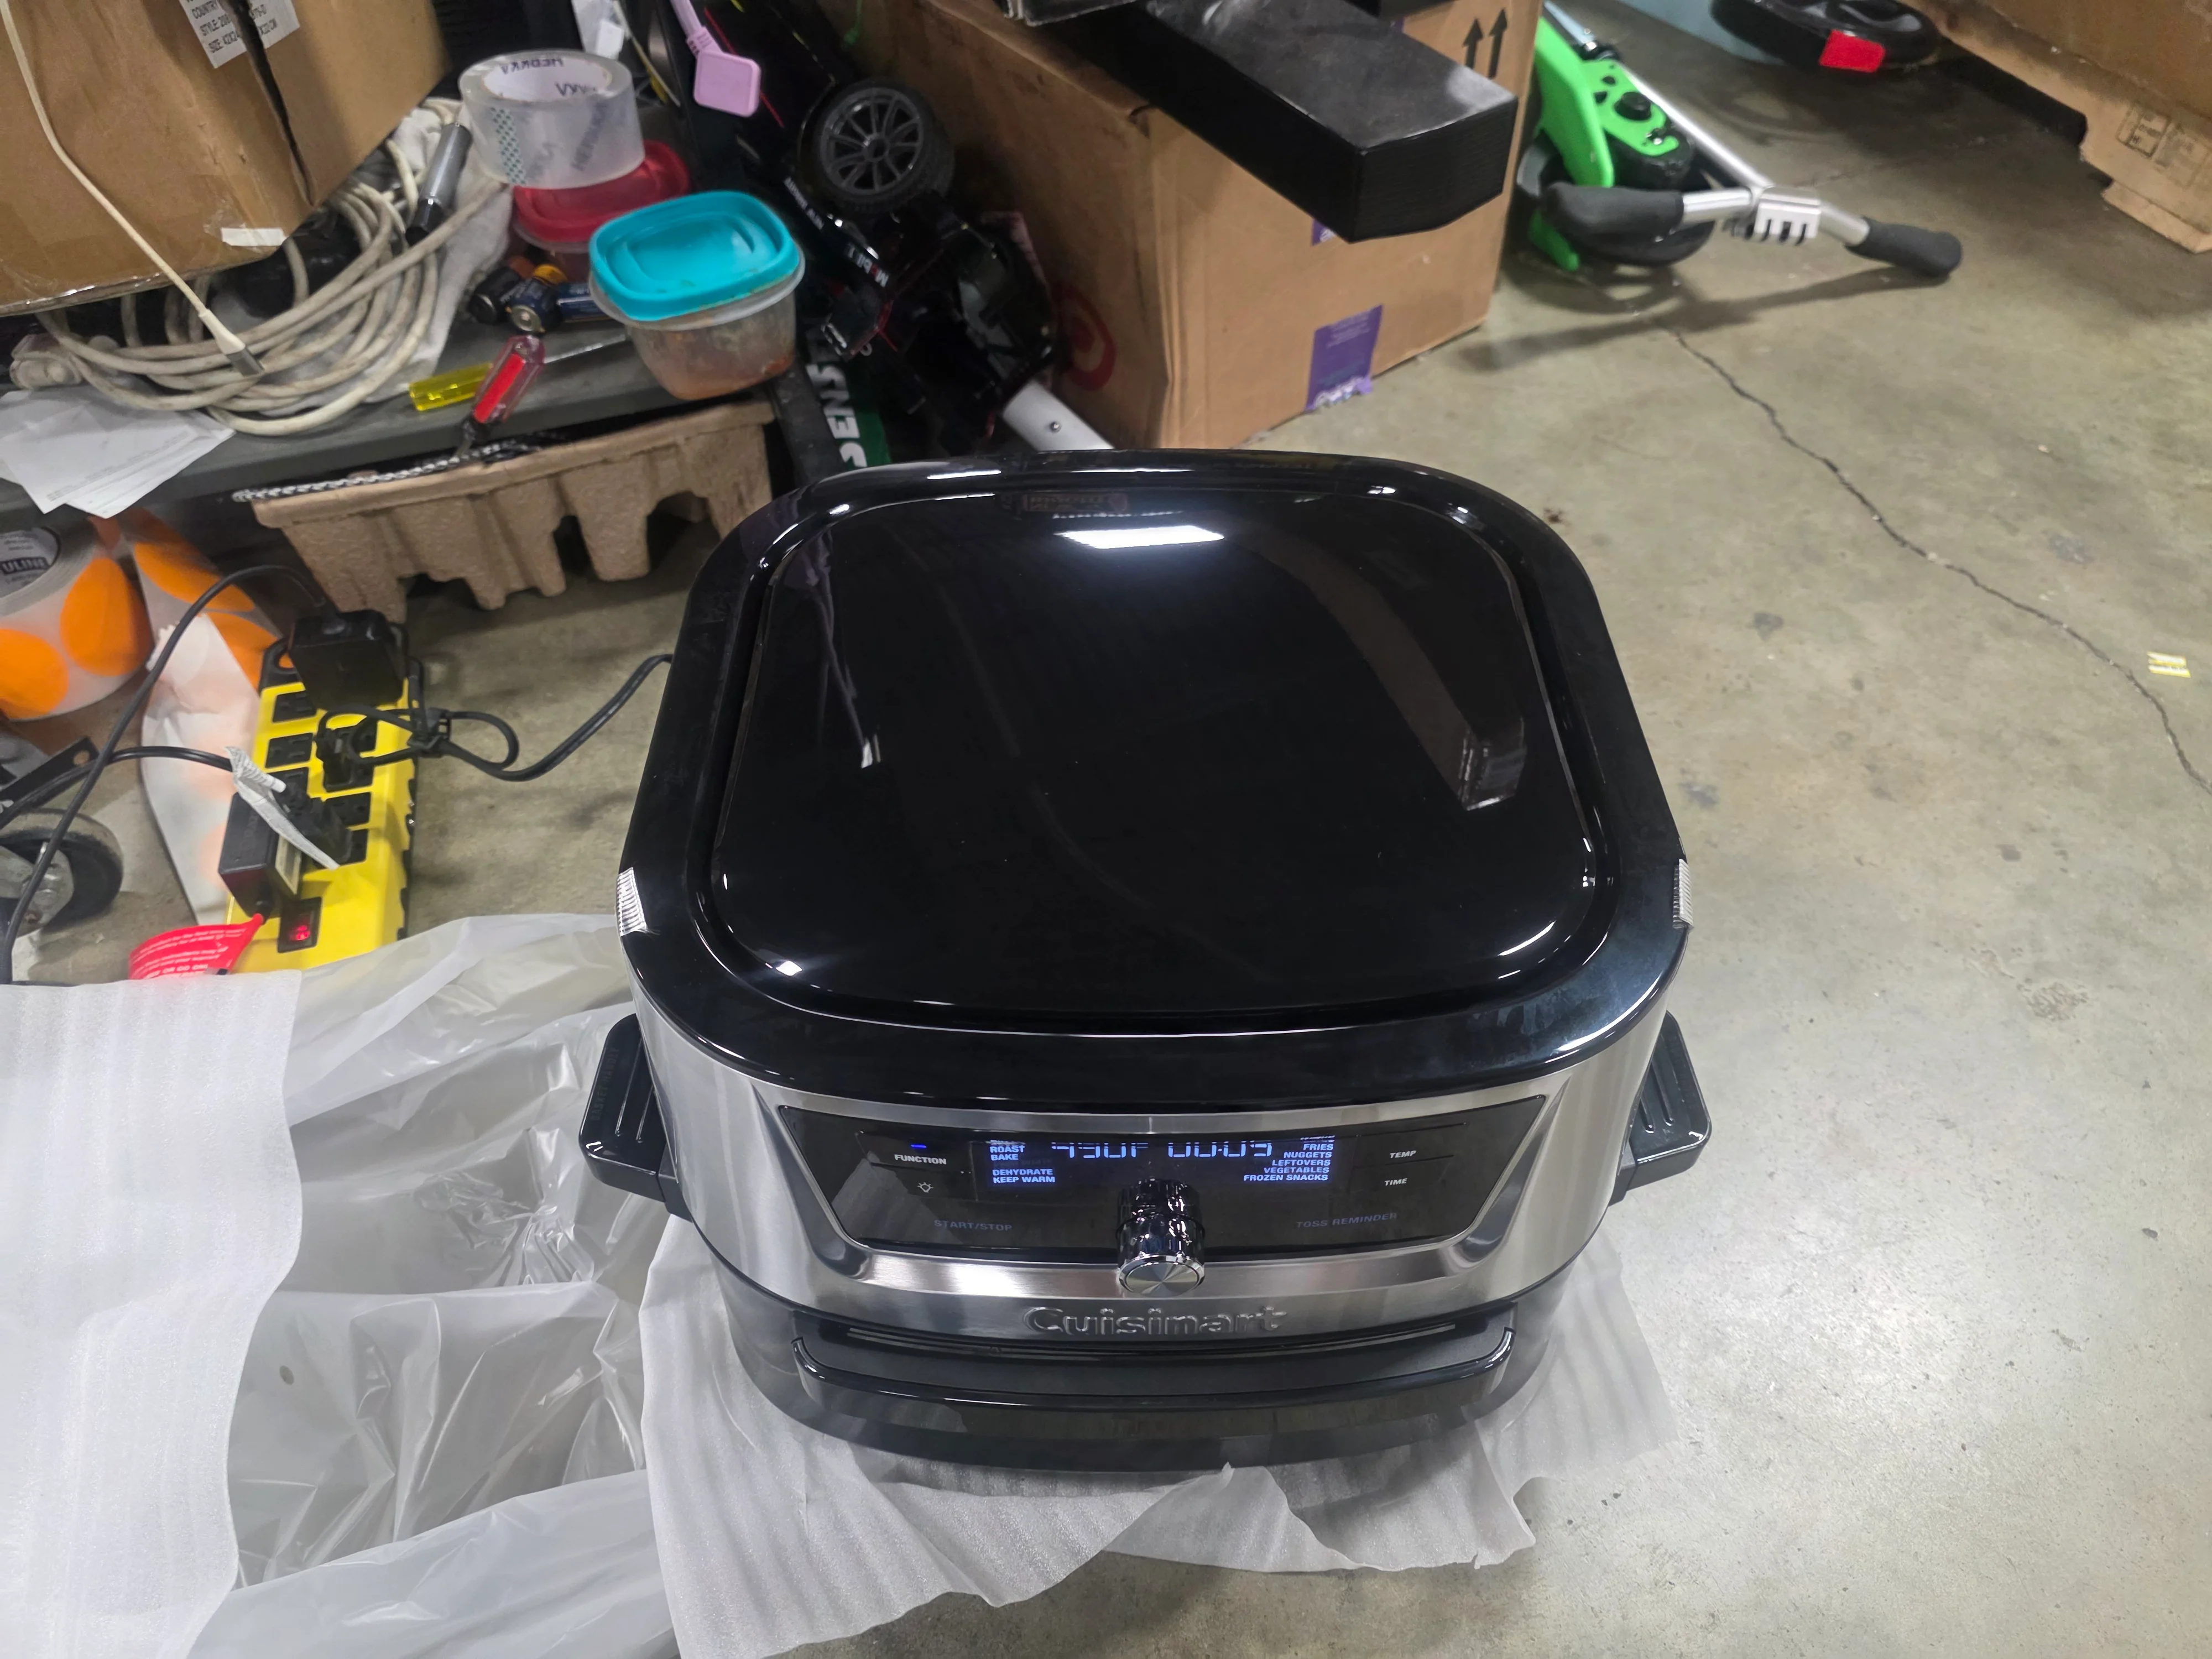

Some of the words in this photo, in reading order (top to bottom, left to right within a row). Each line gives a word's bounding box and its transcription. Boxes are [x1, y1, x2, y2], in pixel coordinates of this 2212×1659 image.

[989, 1145, 1026, 1154] ROAST
[1389, 1150, 1417, 1159] TEMP
[894, 1154, 947, 1165] FUNCTION
[992, 1168, 1053, 1176] DEHYDRATE
[1384, 1177, 1408, 1186] TIME
[1332, 1212, 1397, 1226] REMINDER
[933, 1219, 1013, 1232] START/STOP
[1022, 1305, 1287, 1336] Cuisinart
